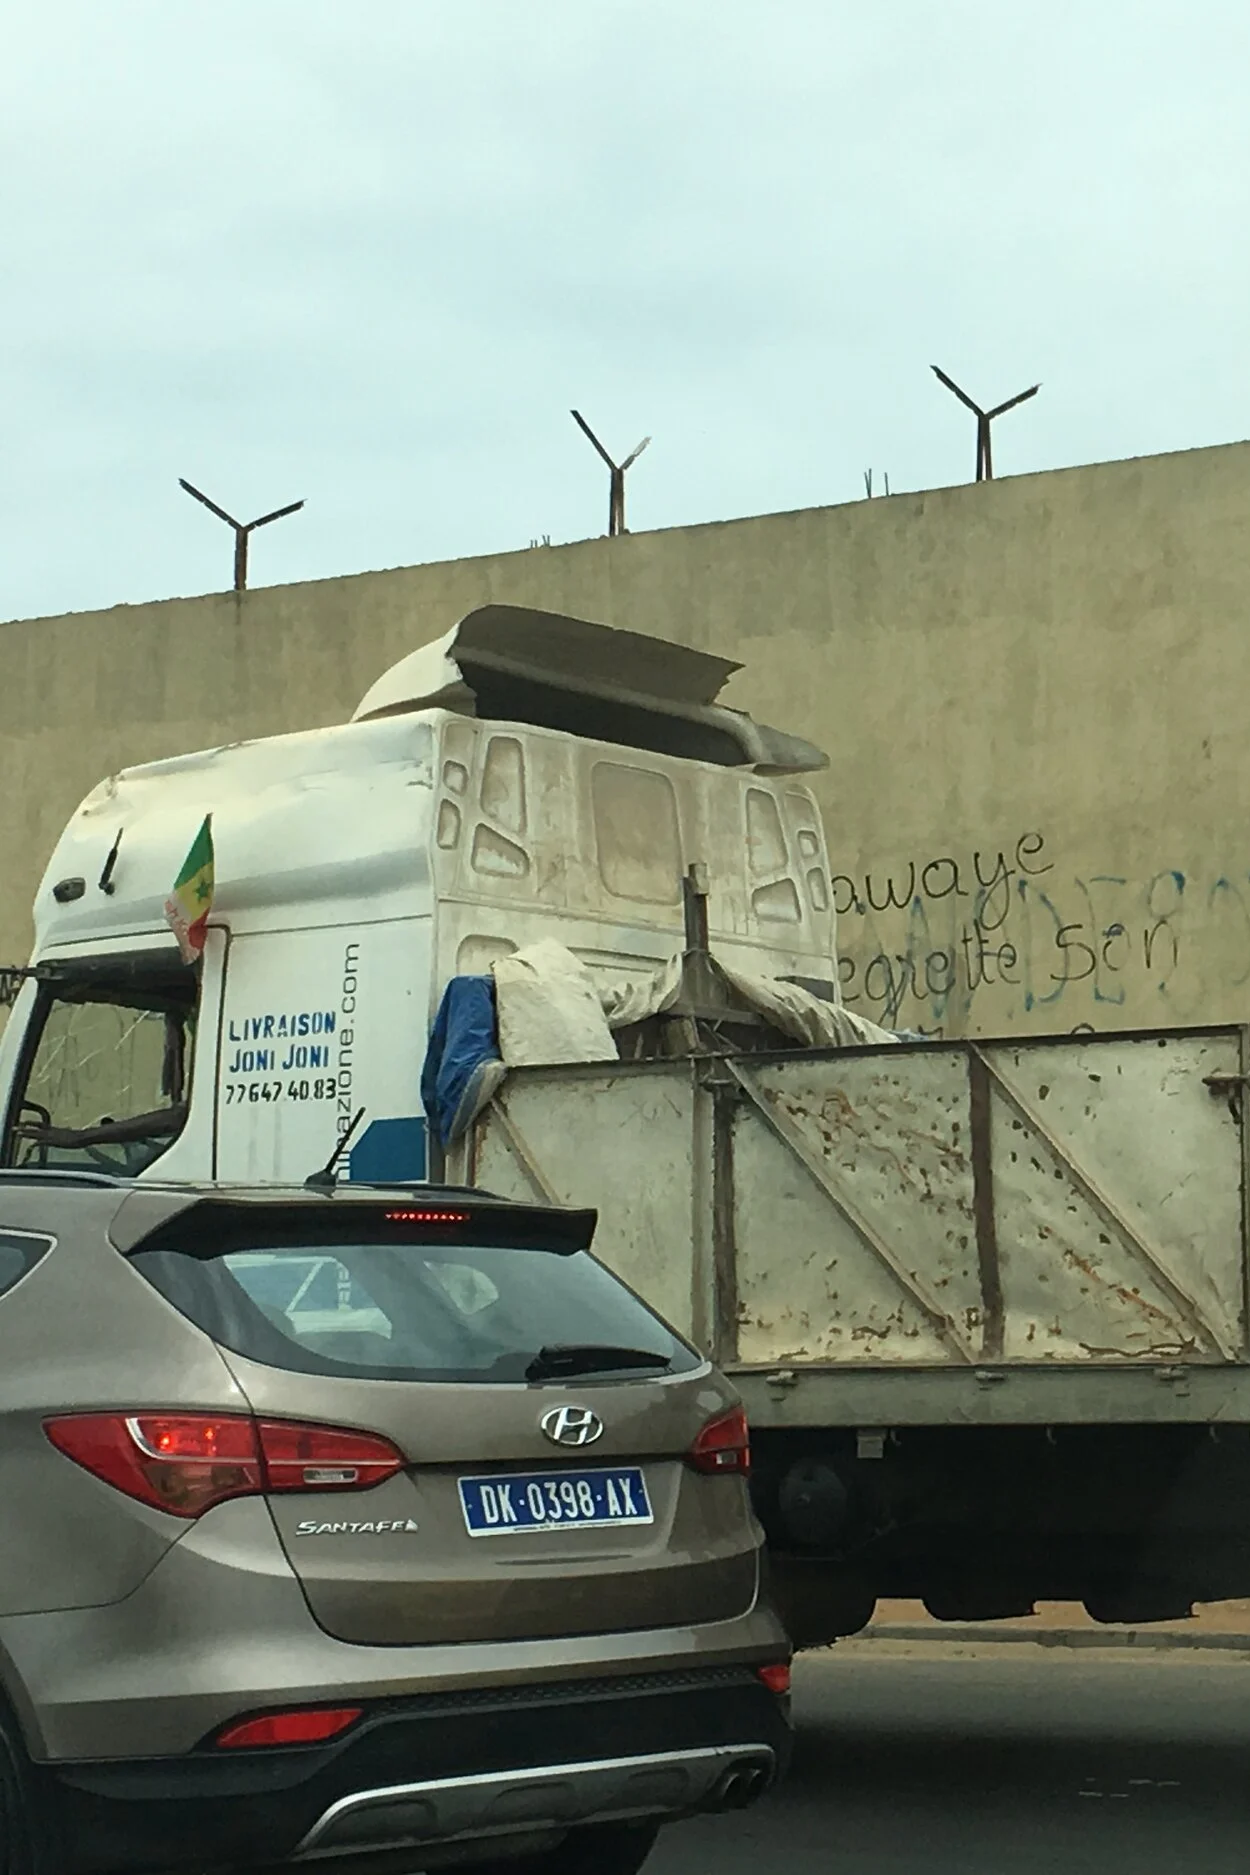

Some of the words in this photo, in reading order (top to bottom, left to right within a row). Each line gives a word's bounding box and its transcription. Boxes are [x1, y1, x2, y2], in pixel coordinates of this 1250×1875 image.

[229, 1011, 336, 1041] LIVRAISON
[229, 1048, 275, 1073] JONI
[282, 1044, 329, 1070] JONI
